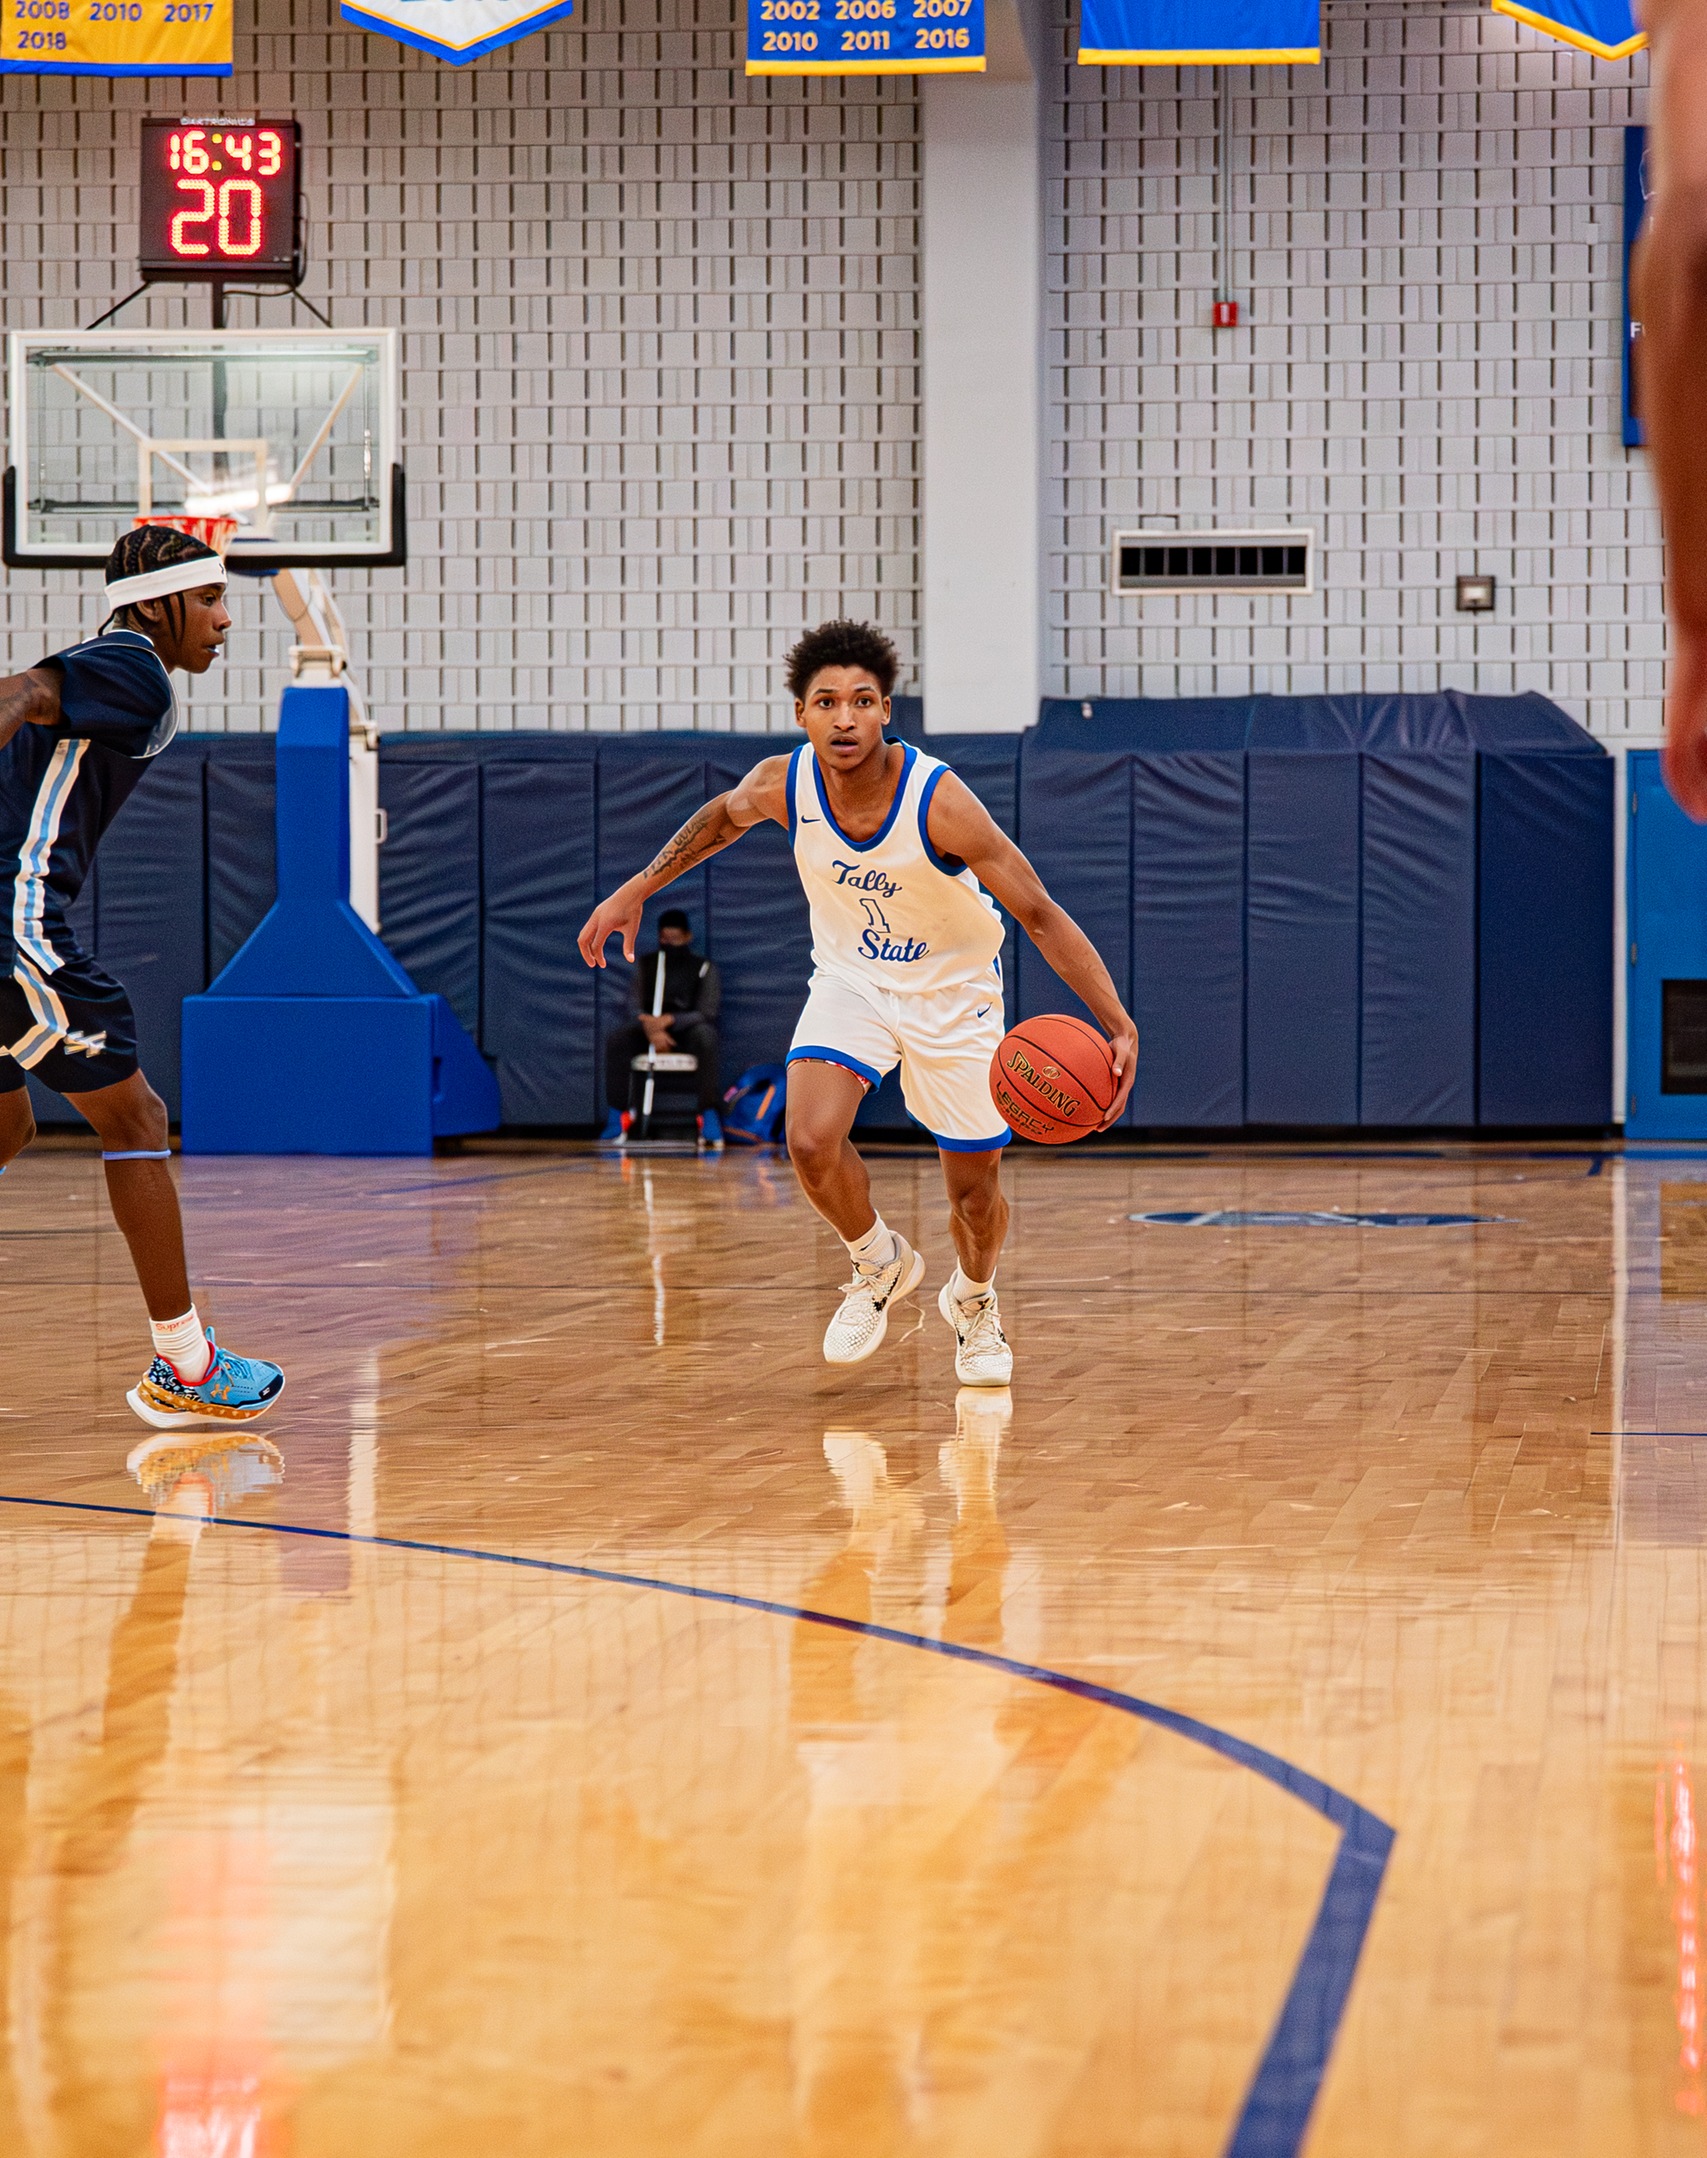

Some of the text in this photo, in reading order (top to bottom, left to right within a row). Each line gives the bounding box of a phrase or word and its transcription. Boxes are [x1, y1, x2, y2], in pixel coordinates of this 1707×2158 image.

[15, 0, 214, 22] 2008 2010 2017
[760, 0, 972, 20] 2002 2006 2007
[17, 31, 67, 50] 2018
[762, 28, 970, 51] 2010 2011 2016
[170, 130, 281, 175] 16:43
[172, 179, 262, 255] 20
[832, 860, 902, 898] Tally
[859, 898, 891, 934] 1
[858, 928, 930, 962] State
[1007, 1050, 1080, 1117] SPALDING
[996, 1080, 1054, 1133] LEGACY
